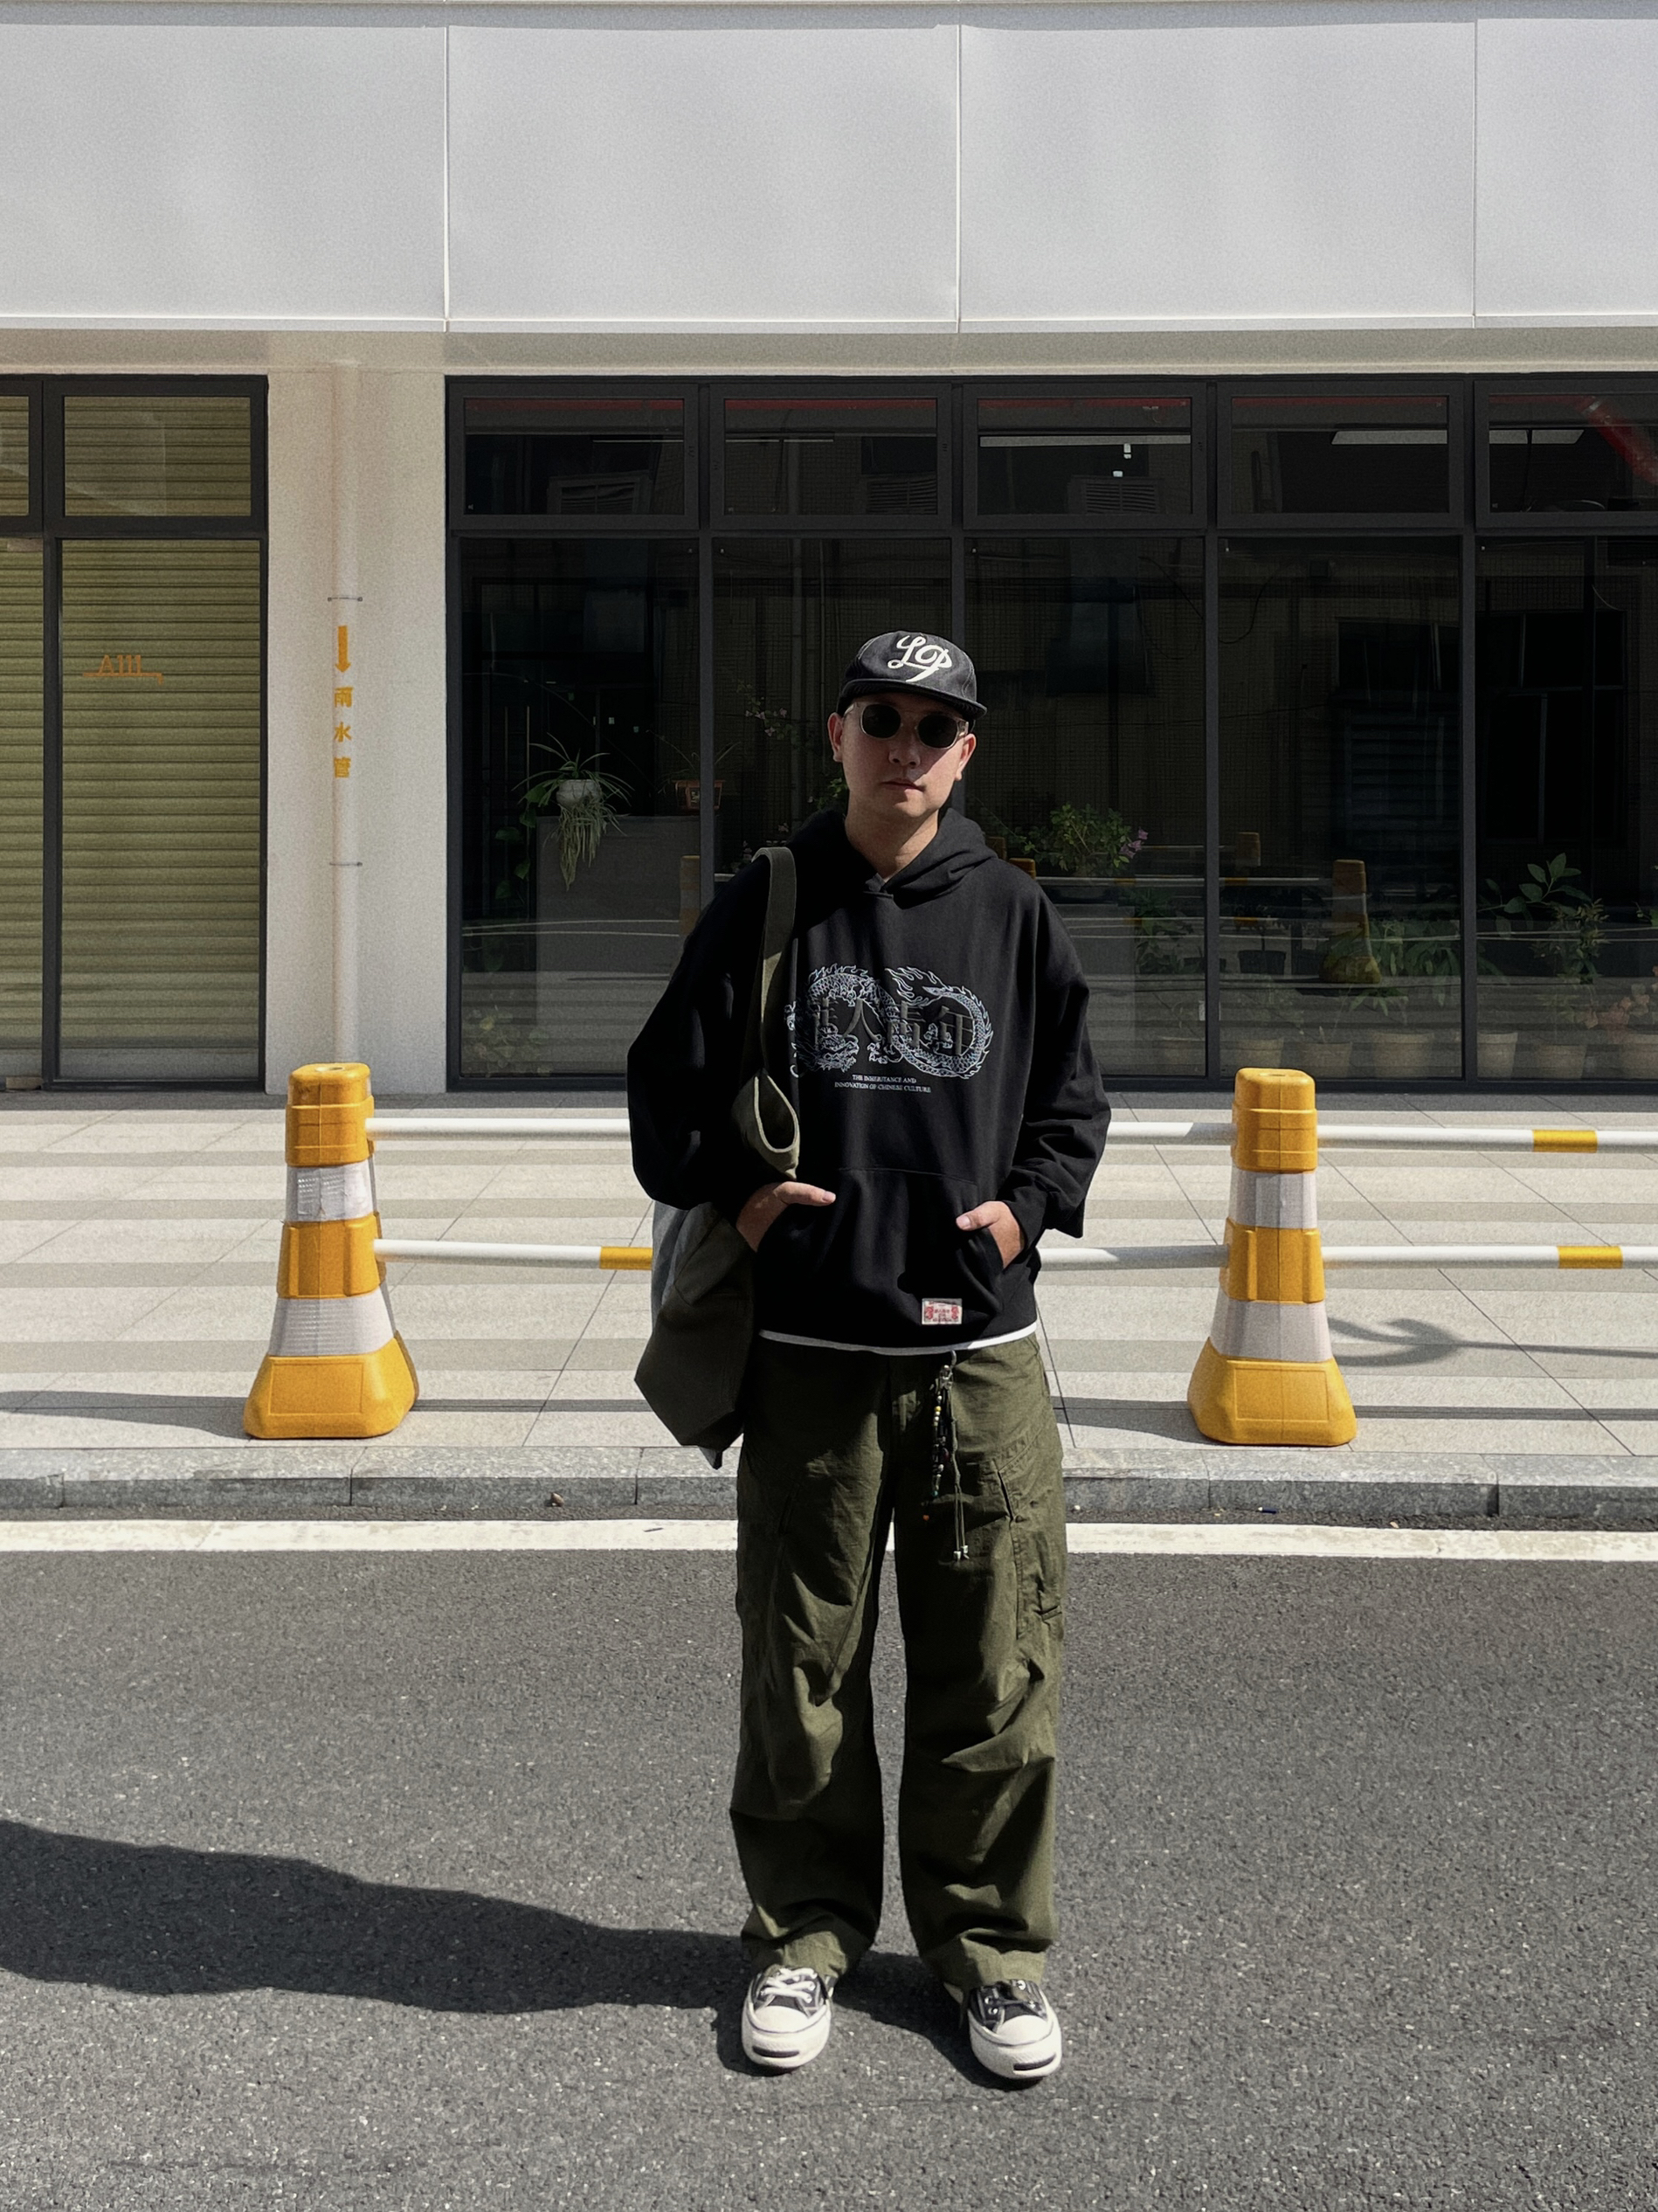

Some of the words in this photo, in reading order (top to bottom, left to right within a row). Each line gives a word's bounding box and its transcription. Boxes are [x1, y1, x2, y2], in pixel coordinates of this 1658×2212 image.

[333, 686, 354, 778] 雨水管
[863, 1075, 902, 1083] INHERITANCE
[834, 1082, 869, 1090] INNOVATION
[903, 1084, 932, 1094] CULTURE
